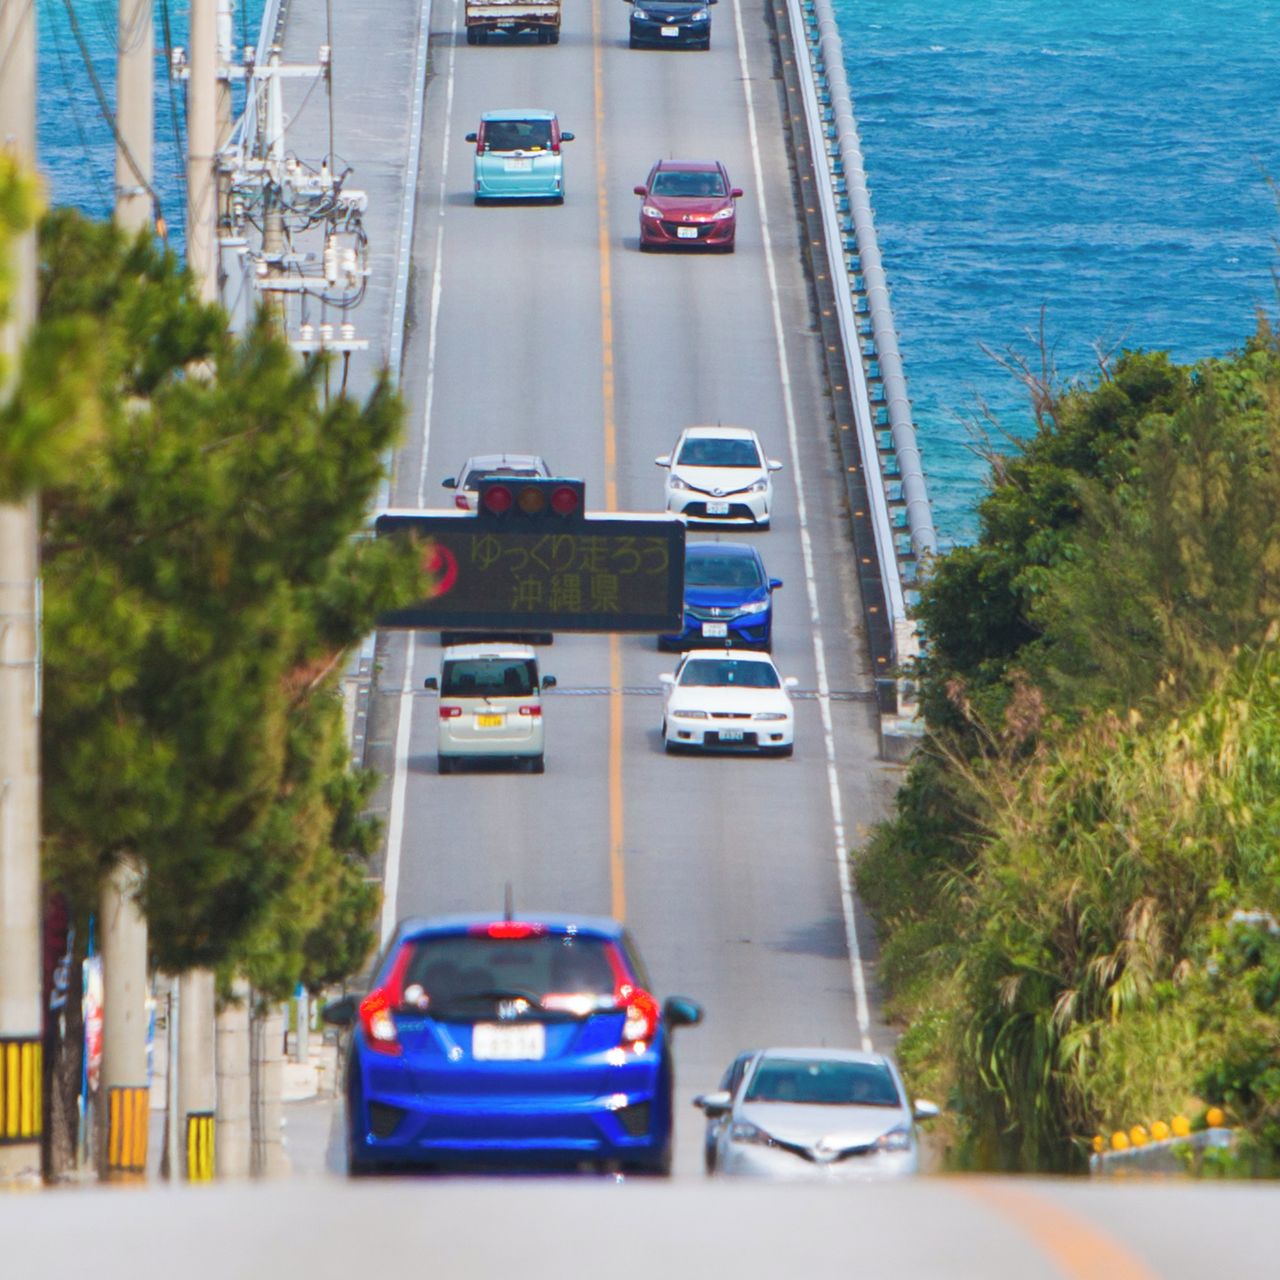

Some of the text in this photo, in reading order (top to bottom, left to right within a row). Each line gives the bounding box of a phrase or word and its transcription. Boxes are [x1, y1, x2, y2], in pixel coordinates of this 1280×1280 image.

[470, 533, 669, 575] ゆっくり走ろう
[511, 571, 619, 611] 沖縄県
